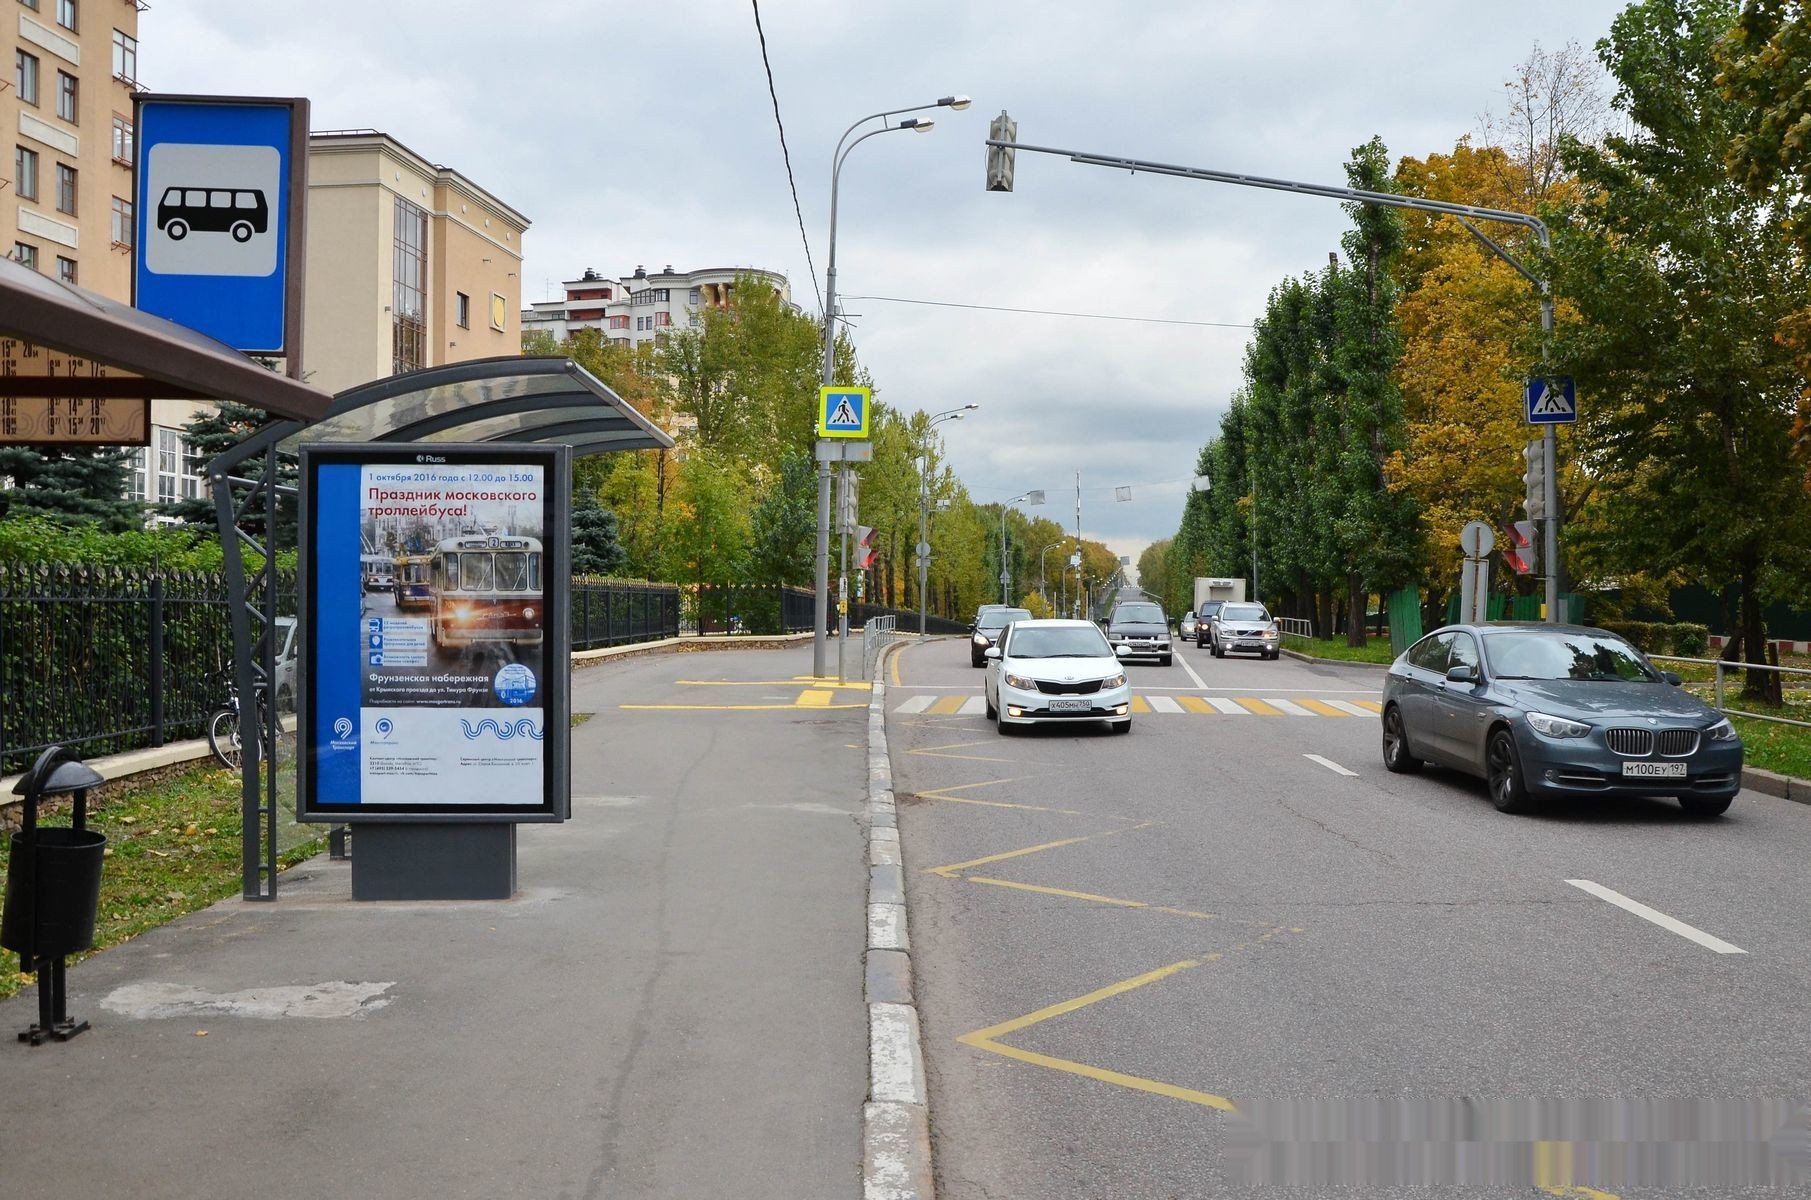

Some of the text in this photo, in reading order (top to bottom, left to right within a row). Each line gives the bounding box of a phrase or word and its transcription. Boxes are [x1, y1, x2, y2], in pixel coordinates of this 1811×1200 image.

[376, 473, 411, 484] октября
[414, 473, 436, 482] 2016
[438, 475, 458, 483] года
[468, 474, 493, 482] 12.00
[509, 474, 534, 482] 15.00
[368, 488, 441, 503] Праздник
[368, 504, 467, 518] троллейбуса!
[369, 673, 489, 683] Фрунзенская набережная
[1626, 764, 1684, 774] М100ЕУ 197
